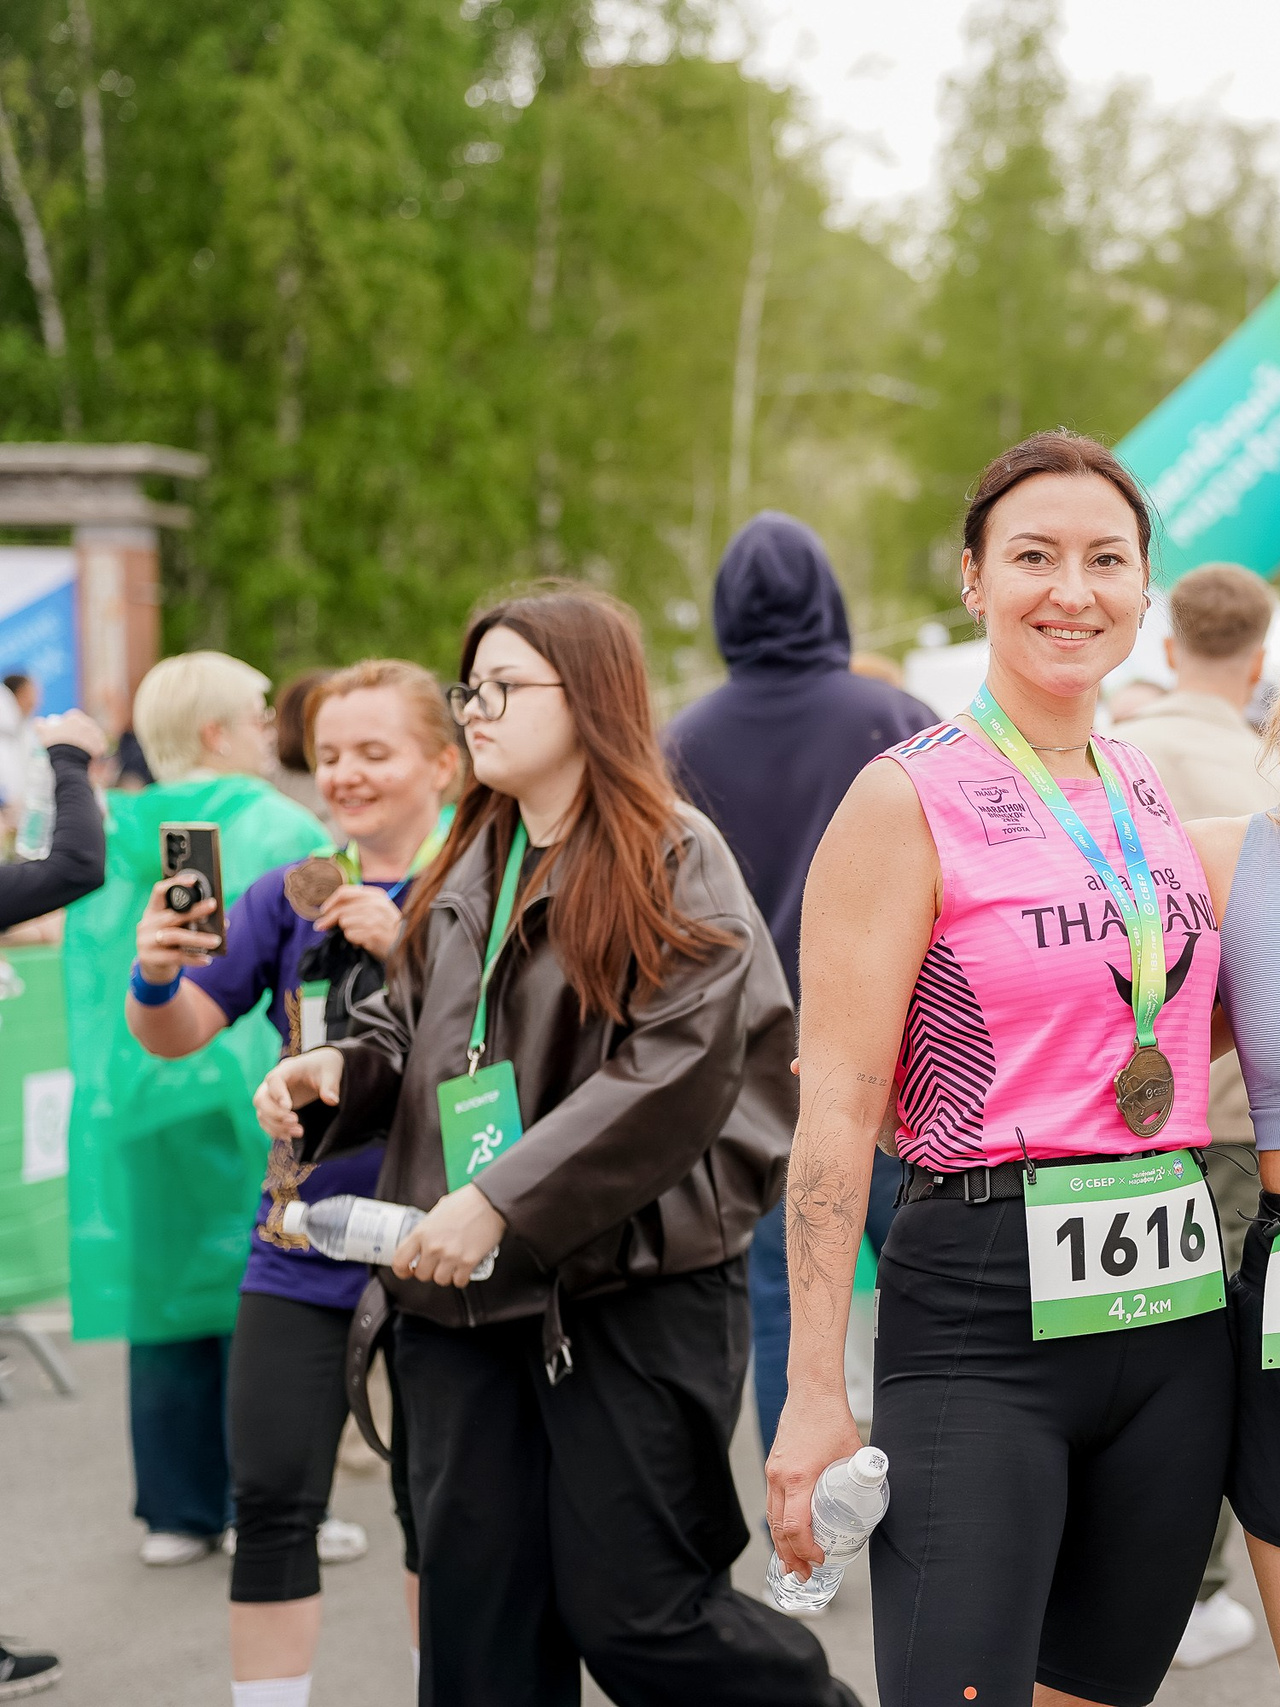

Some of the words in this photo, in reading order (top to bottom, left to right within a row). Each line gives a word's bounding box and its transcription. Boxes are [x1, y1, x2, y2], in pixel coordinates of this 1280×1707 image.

[989, 718, 1005, 736] 185
[978, 803, 1026, 813] MARATHON
[1002, 826, 1030, 835] TOYOTA
[1073, 830, 1091, 849] Utair
[1136, 873, 1150, 900] СБЕР
[1112, 884, 1131, 912] СБЕР
[1085, 1177, 1116, 1188] СБЕР
[1056, 1197, 1206, 1282] 1616
